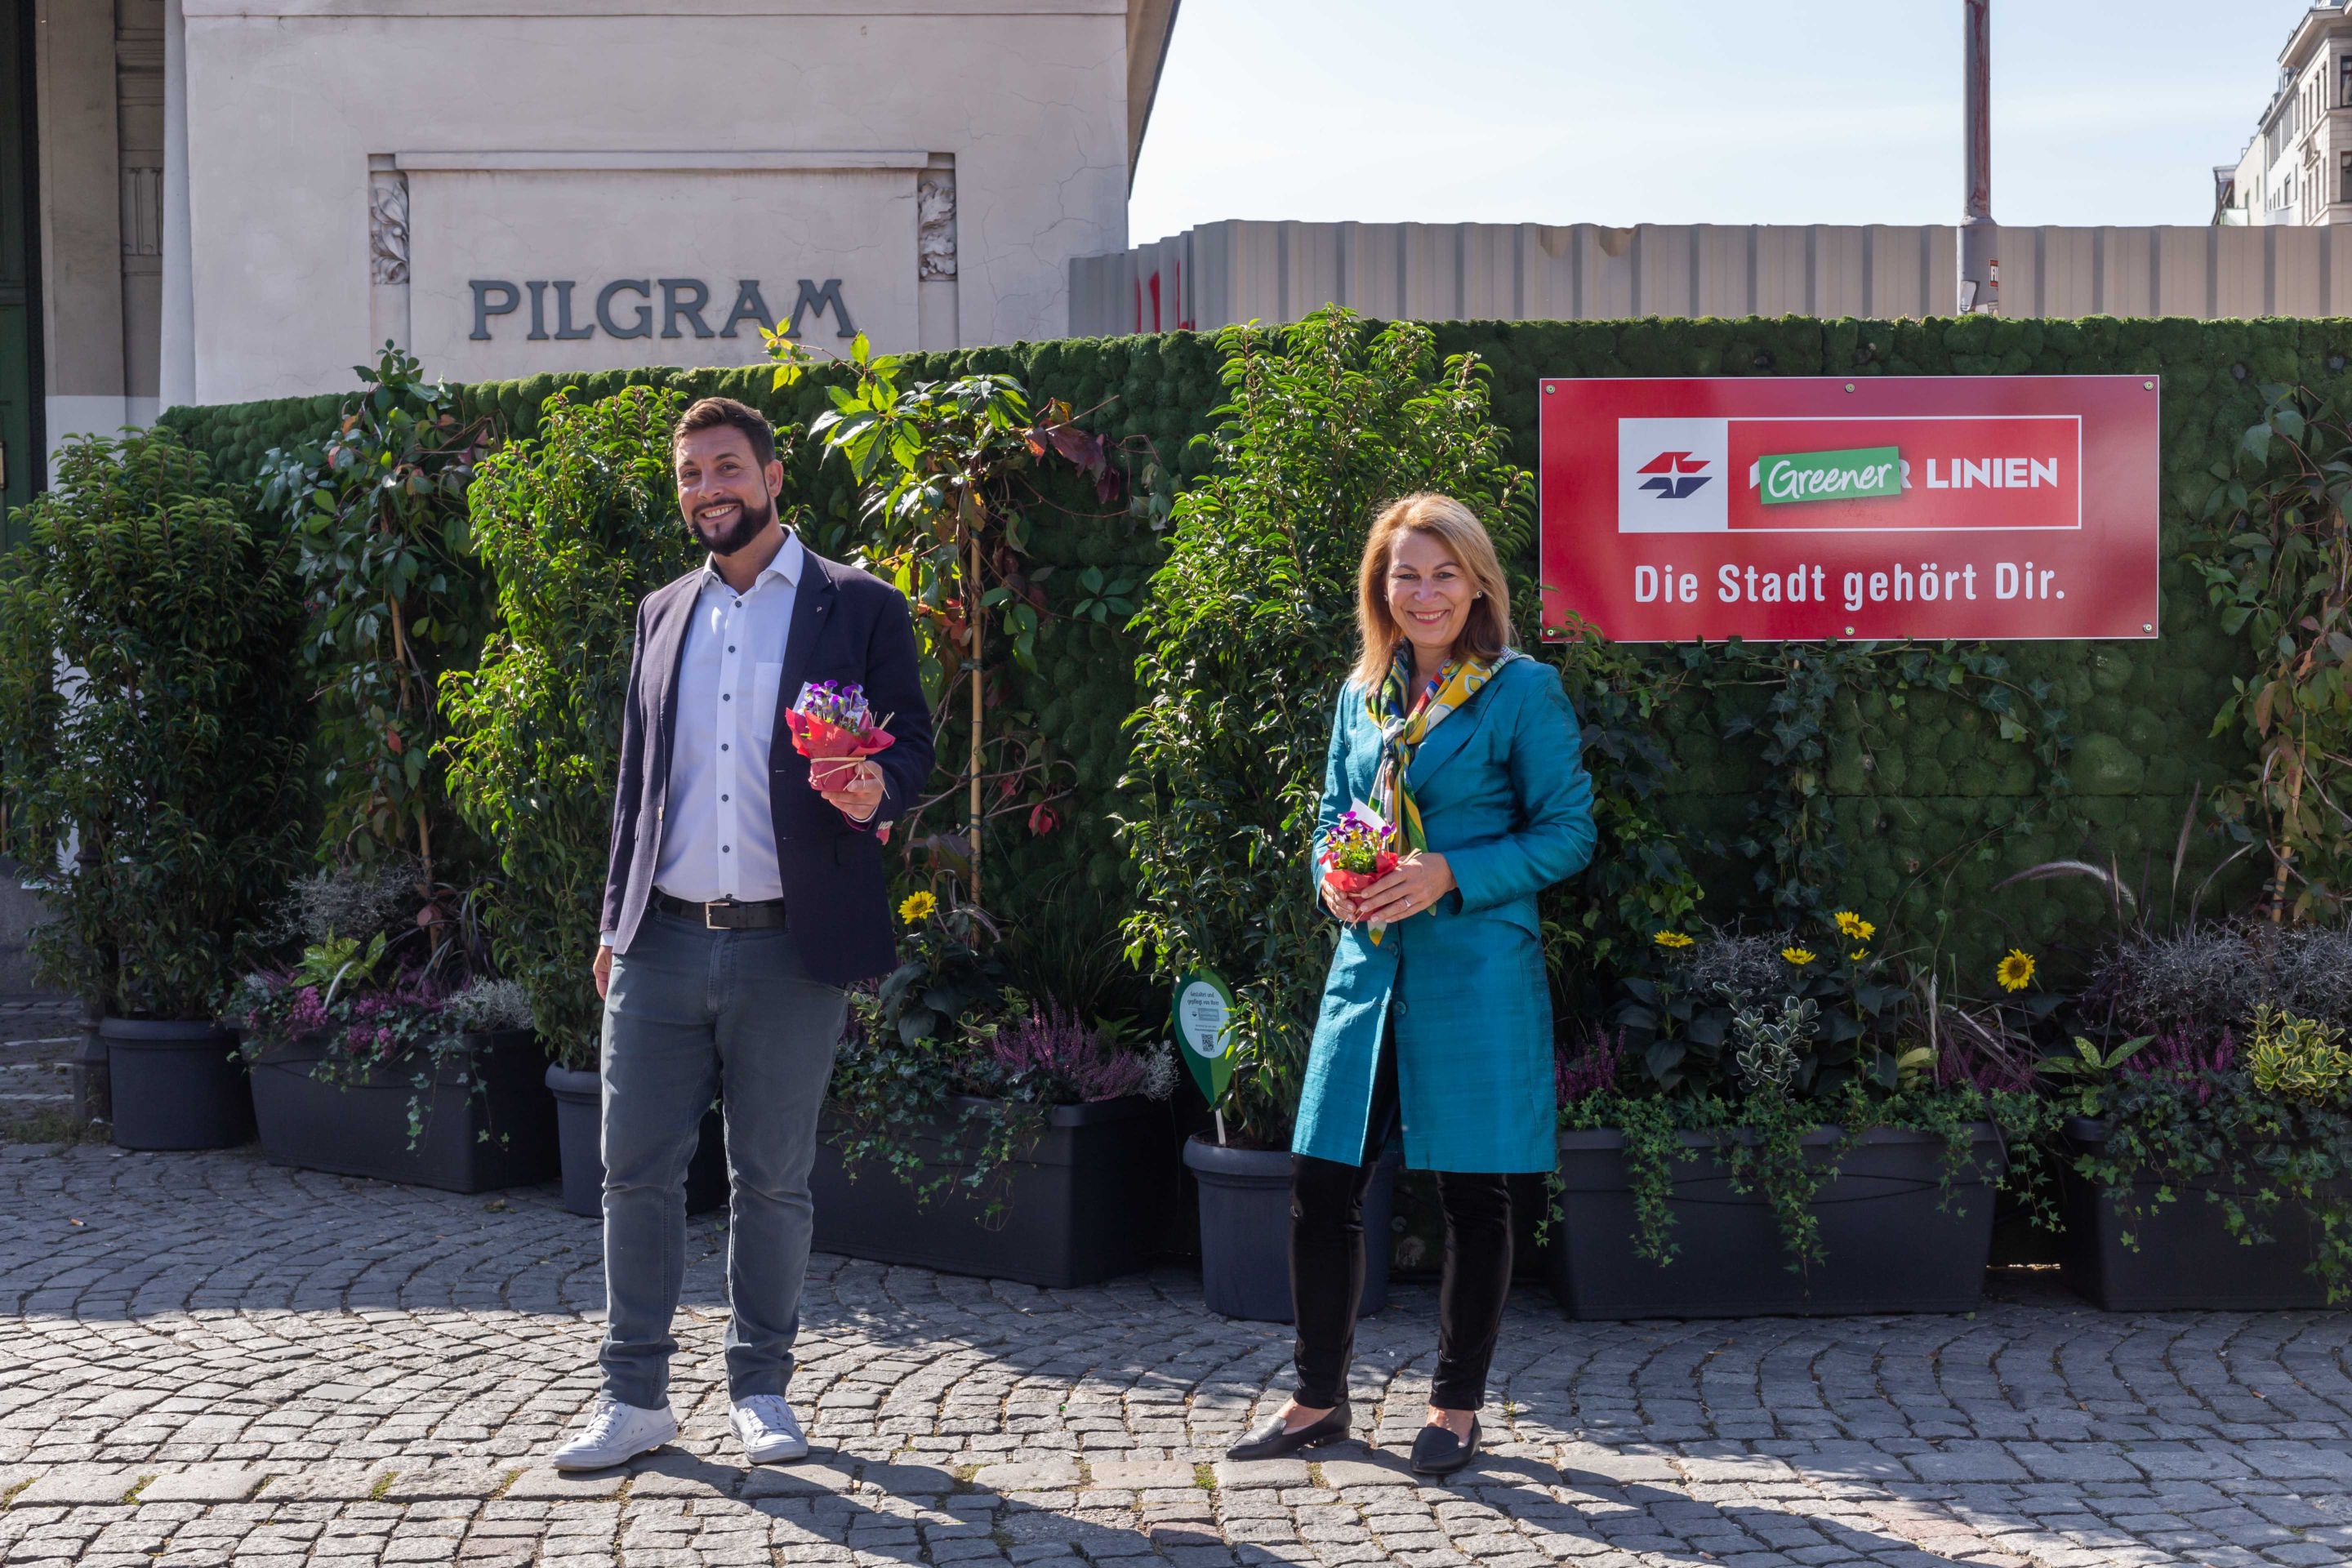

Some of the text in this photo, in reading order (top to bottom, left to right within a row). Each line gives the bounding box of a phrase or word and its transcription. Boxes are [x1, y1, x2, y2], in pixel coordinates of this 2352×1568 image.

[469, 278, 859, 341] PILGRAM
[1768, 460, 1892, 500] Greener
[1927, 457, 2058, 489] LINIEN
[1635, 561, 2065, 612] Die Stadt gehört Dir.
